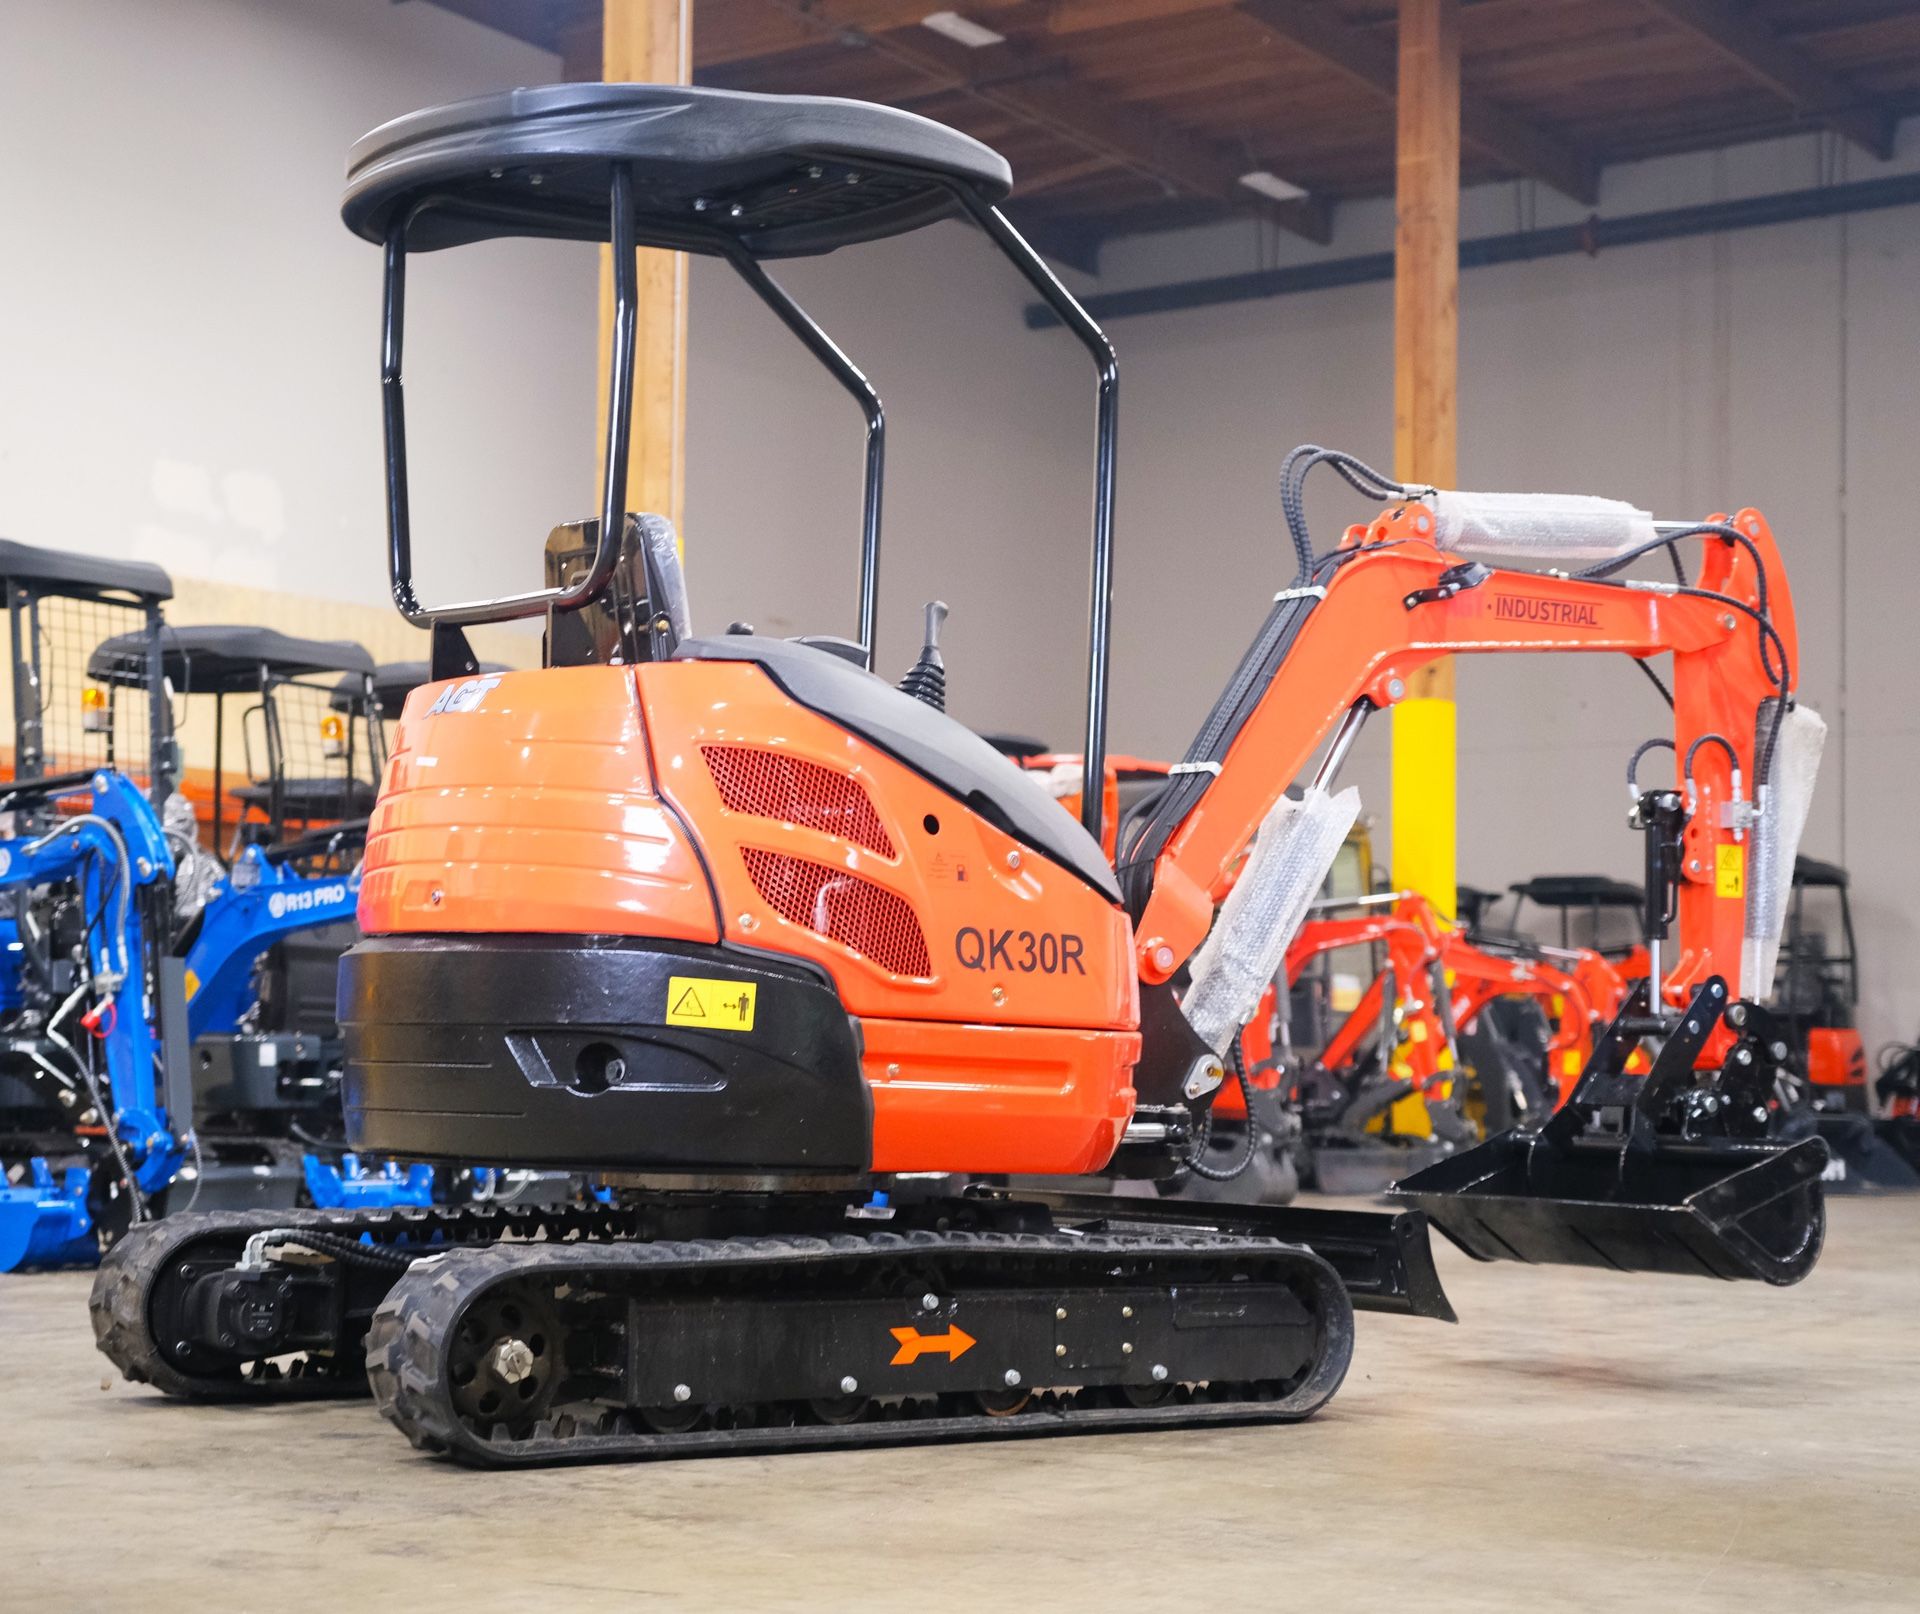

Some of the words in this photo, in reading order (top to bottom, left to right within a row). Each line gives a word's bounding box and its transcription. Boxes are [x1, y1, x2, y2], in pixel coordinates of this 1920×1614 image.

[1495, 597, 1598, 625] INDUSTRIAL
[286, 890, 313, 912] R13
[314, 884, 346, 907] PRO
[955, 926, 1086, 975] QK30R
